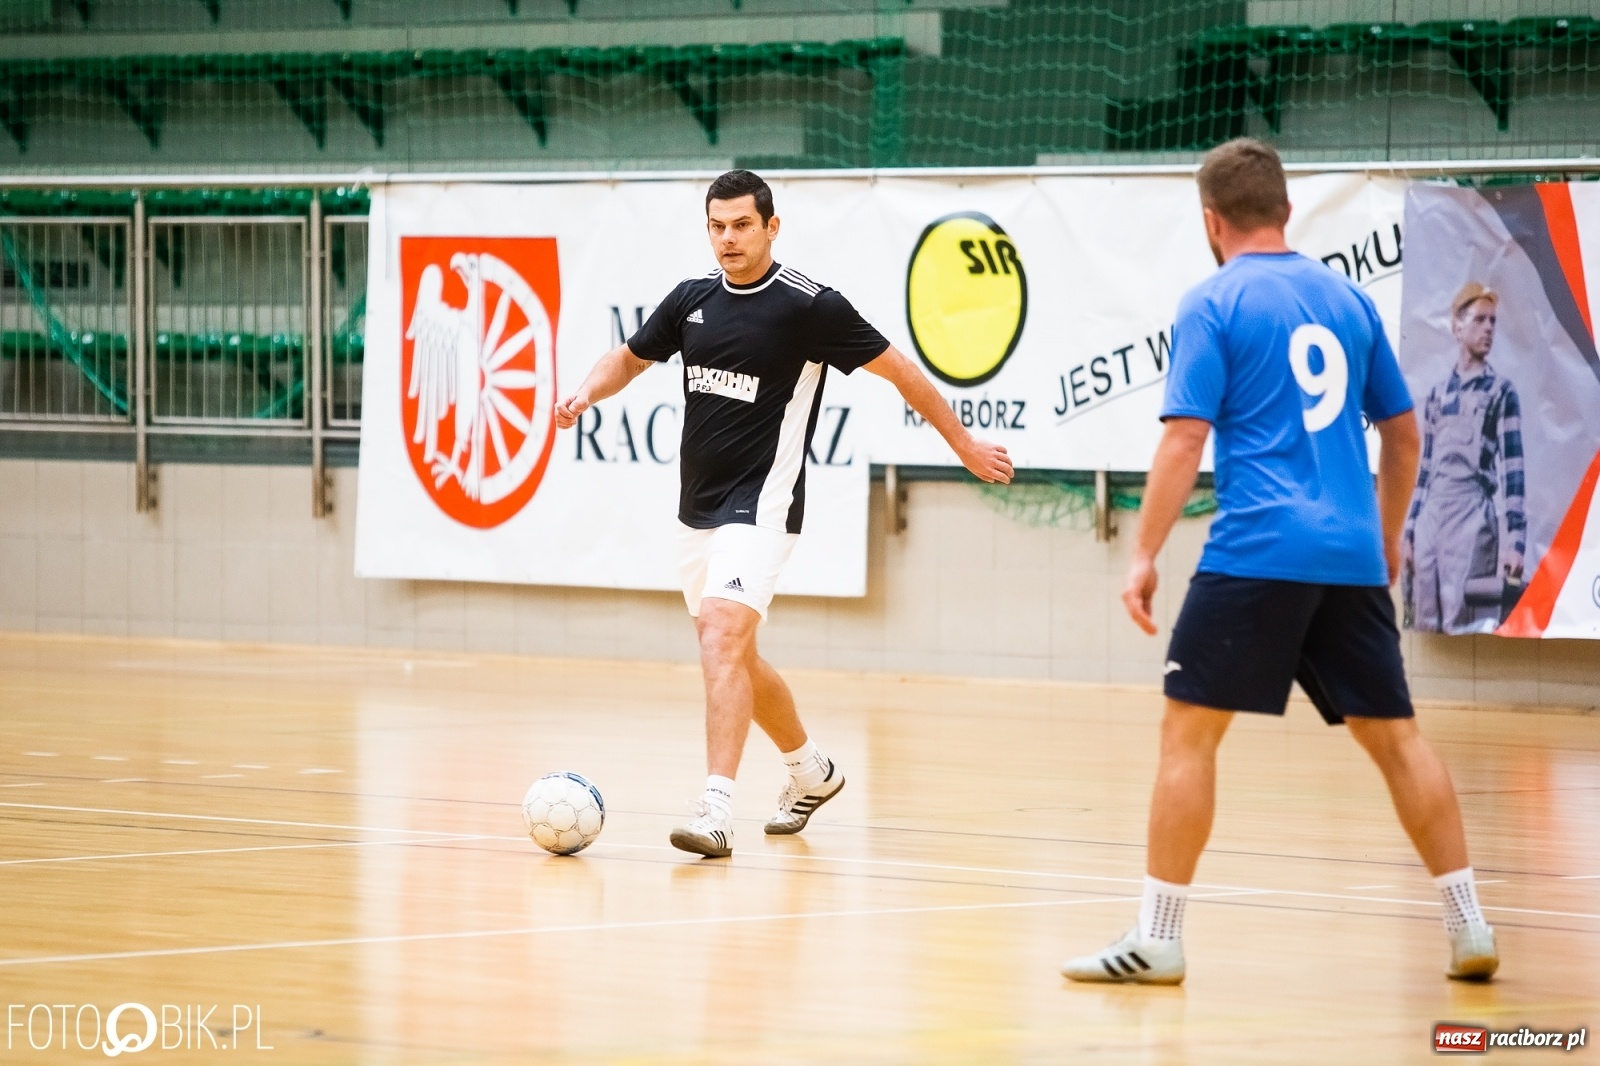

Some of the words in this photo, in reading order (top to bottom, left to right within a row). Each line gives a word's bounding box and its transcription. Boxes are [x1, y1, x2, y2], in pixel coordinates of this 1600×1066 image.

[702, 367, 760, 401] KUHN
[1055, 344, 1134, 416] JEST
[1288, 323, 1348, 433] 9
